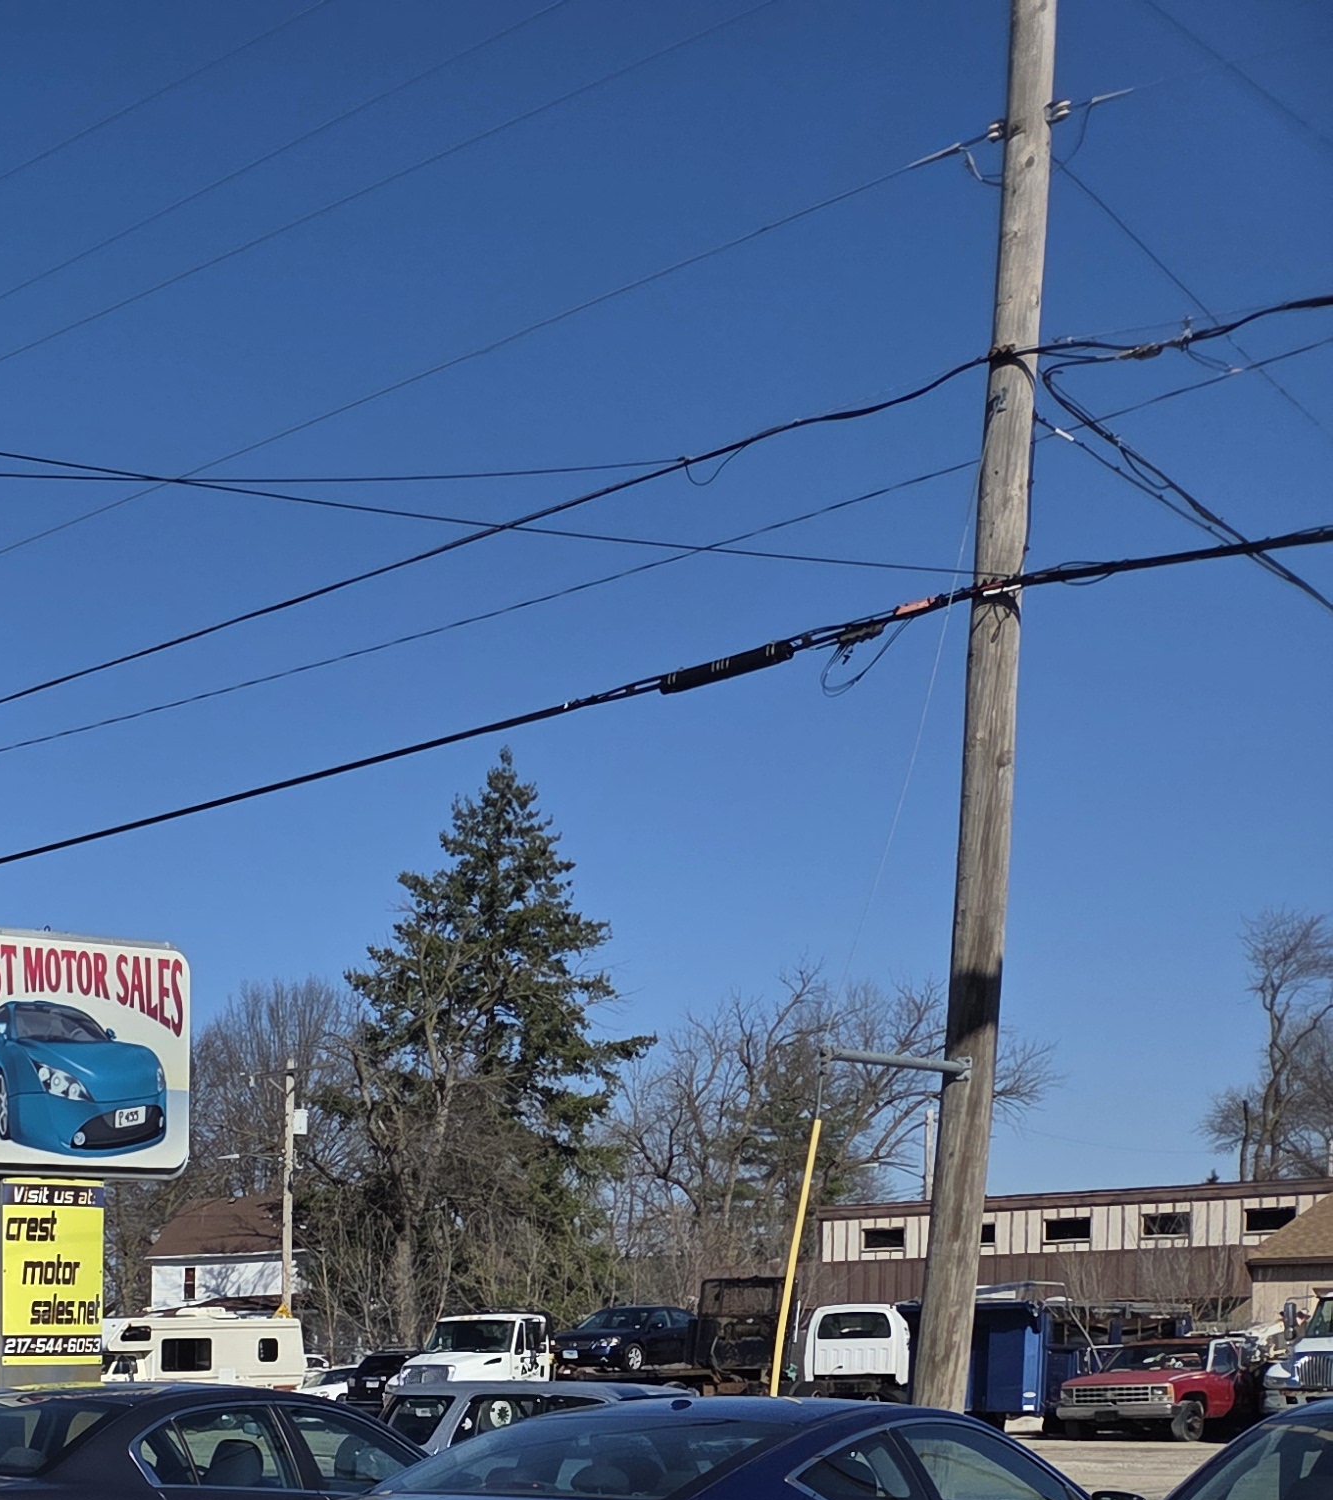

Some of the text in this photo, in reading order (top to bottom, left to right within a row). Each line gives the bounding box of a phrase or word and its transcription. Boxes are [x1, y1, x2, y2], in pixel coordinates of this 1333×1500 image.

[23, 946, 110, 1000] MOTOR
[116, 954, 183, 1037] SALES
[14, 1186, 96, 1205] Visit us at:
[5, 1210, 57, 1241] crest
[22, 1254, 80, 1285] motor
[30, 1293, 100, 1325] sales.net
[4, 1338, 101, 1354] 217-544-6053
